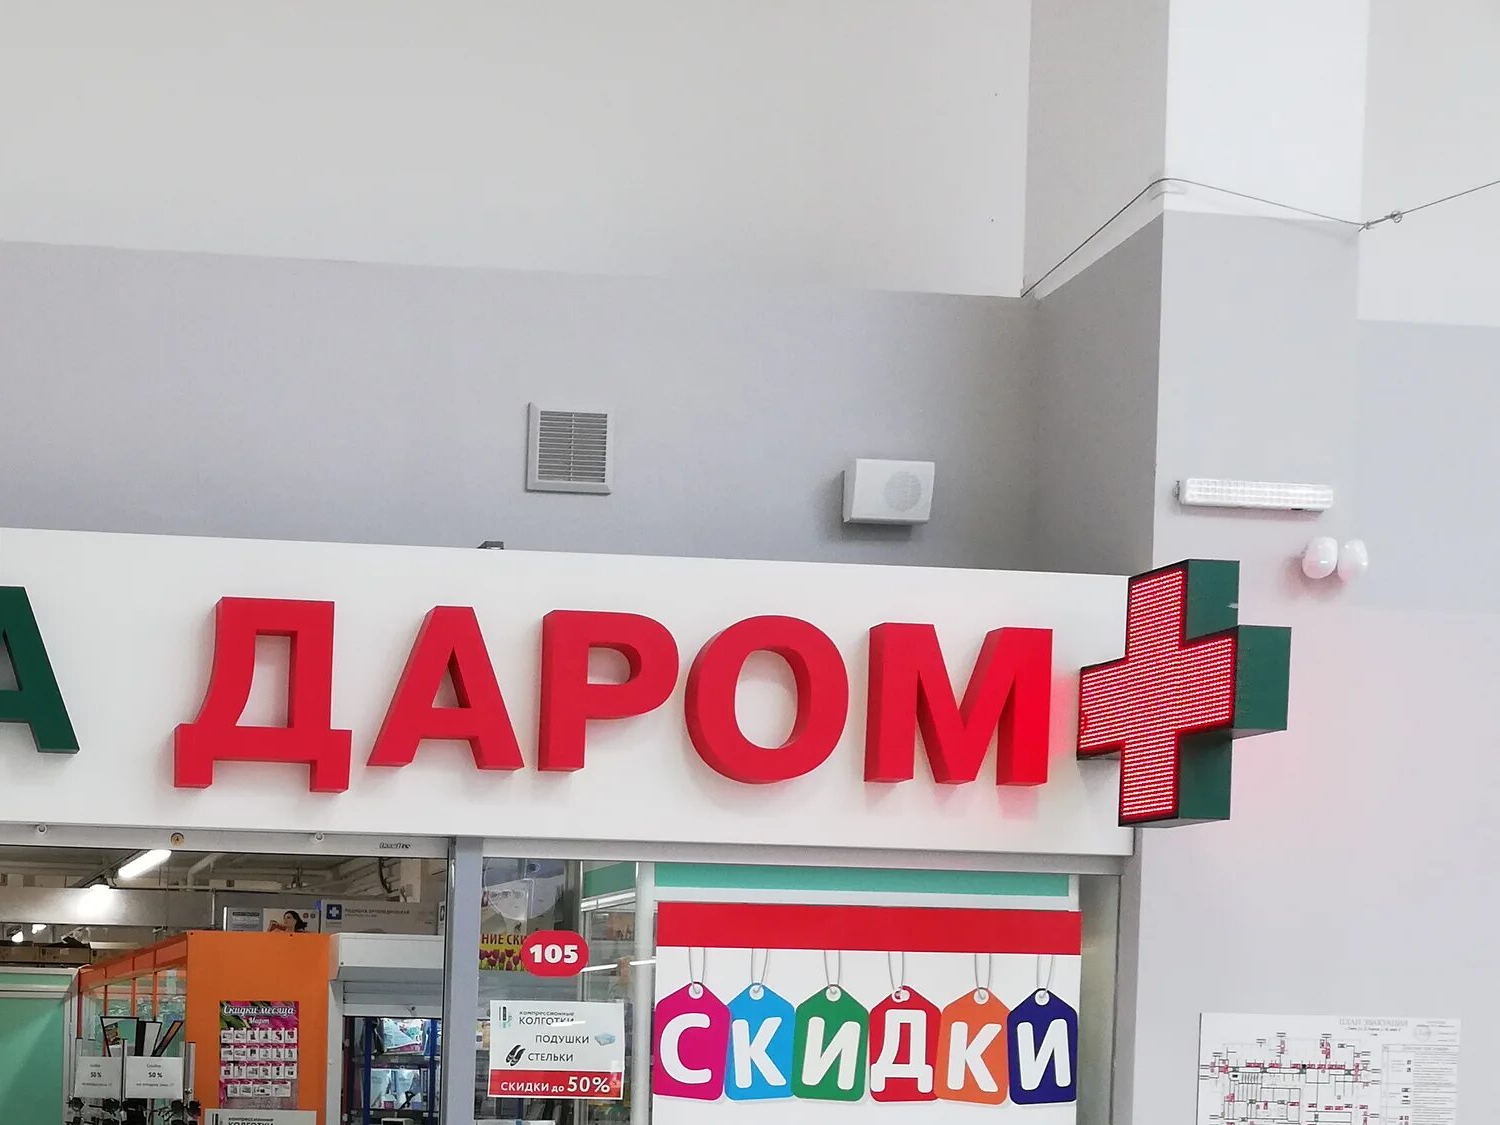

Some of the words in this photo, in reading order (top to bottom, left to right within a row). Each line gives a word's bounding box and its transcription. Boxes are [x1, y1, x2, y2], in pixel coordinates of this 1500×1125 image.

[175, 596, 1052, 794] ДАРОМ
[529, 944, 579, 964] 105
[223, 1005, 257, 1017] Скидки
[259, 1006, 294, 1018] месяца
[249, 1017, 270, 1025] Март
[519, 1016, 575, 1026] КОЛГОТКИ
[535, 1034, 589, 1045] ПОДУШКИ
[528, 1052, 574, 1062] СТЕЛЬКИ
[659, 1009, 1072, 1093] СКИДКИ
[501, 1081, 549, 1093] СКИДКИ
[551, 1085, 565, 1093] до
[567, 1076, 610, 1093] 50%
